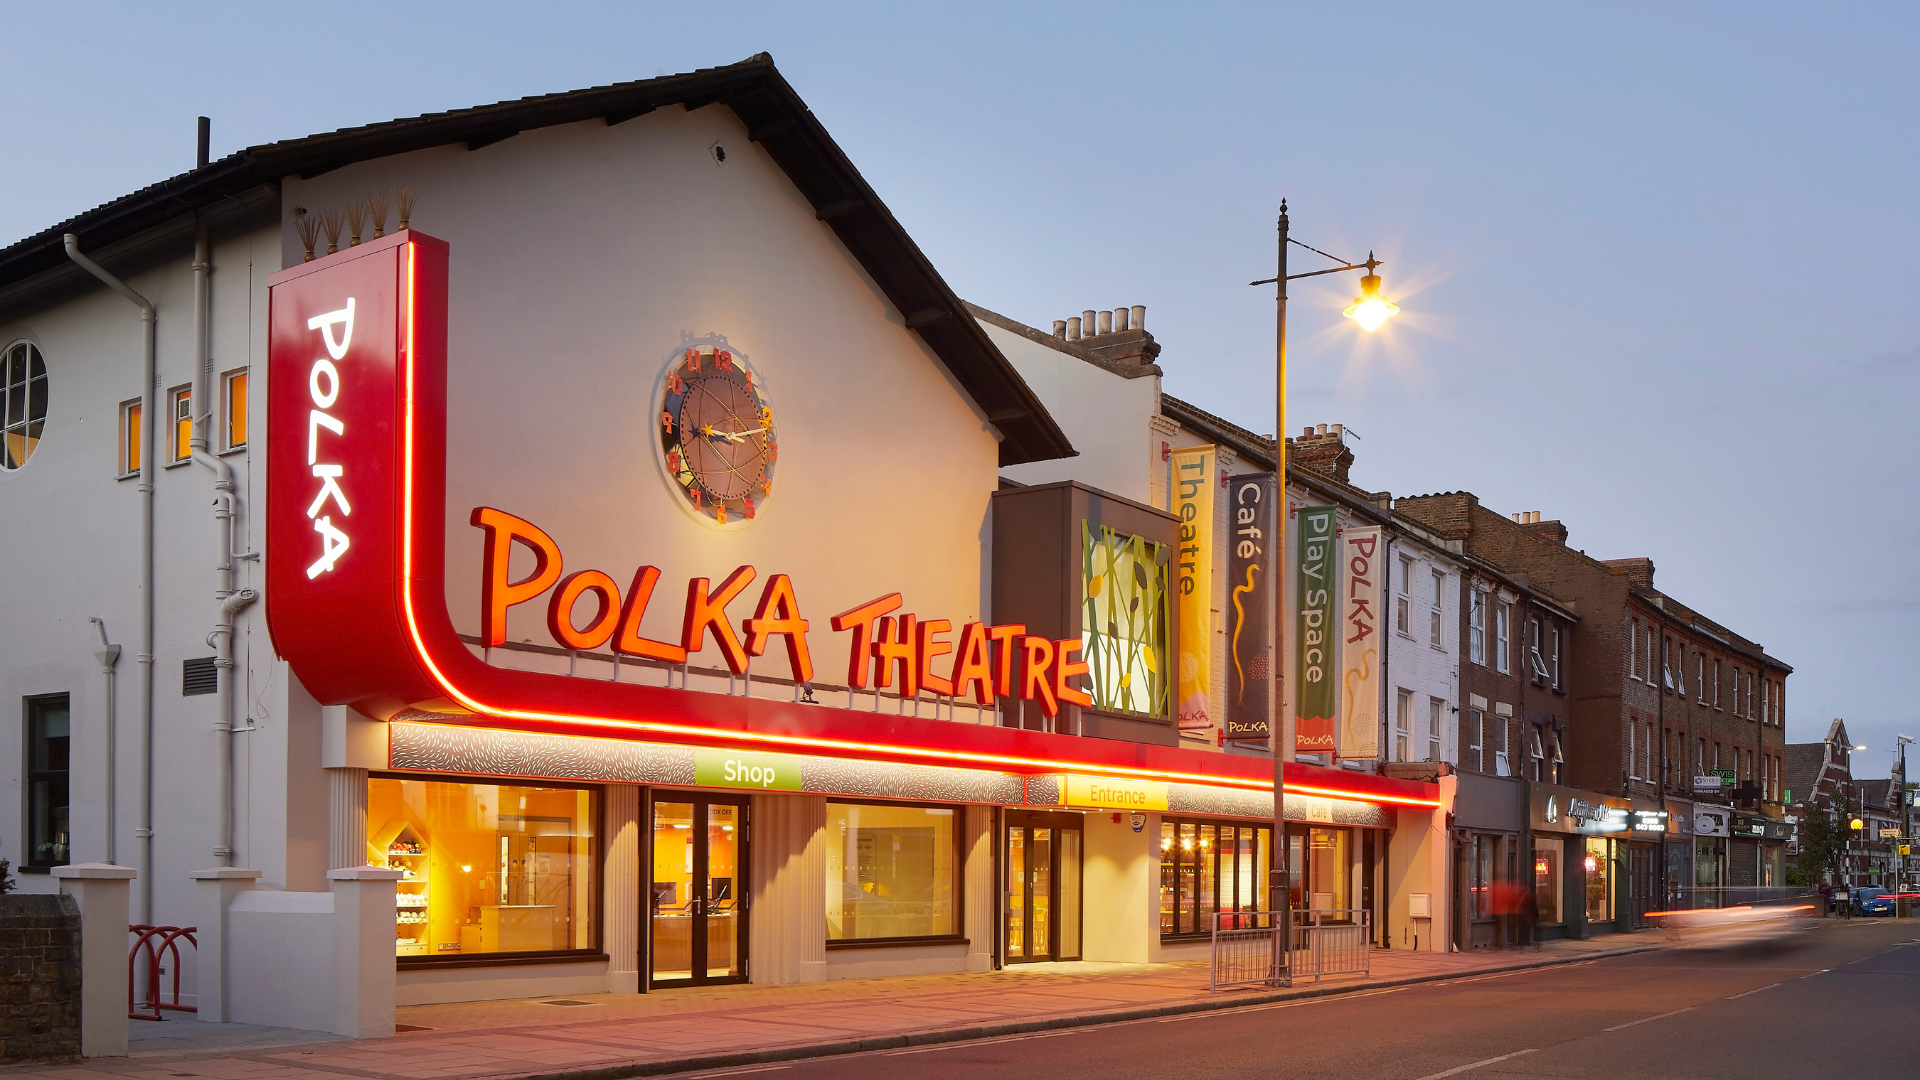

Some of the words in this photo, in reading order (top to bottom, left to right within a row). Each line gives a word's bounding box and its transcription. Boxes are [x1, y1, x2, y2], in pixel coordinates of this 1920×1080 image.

[714, 347, 733, 373] 12
[662, 412, 673, 434] 9
[306, 296, 355, 581] POLKA
[668, 451, 680, 473] 8
[767, 441, 778, 462] 3
[690, 488, 702, 511] 7
[744, 499, 755, 520] 5
[716, 504, 728, 525] 6
[1180, 454, 1205, 596] Theatre
[1237, 482, 1262, 559] Café
[1302, 513, 1329, 581] Play
[1347, 533, 1377, 645] POLKA
[470, 506, 814, 685] POLKA
[831, 592, 1093, 718] THEATRE
[1301, 588, 1328, 684] Space
[1228, 721, 1268, 733] POLKA
[1296, 734, 1334, 746] POLKA
[724, 759, 776, 788] Shop
[1710, 770, 1733, 778] SW19
[1089, 784, 1145, 807] Entrance
[1311, 804, 1328, 819] Café
